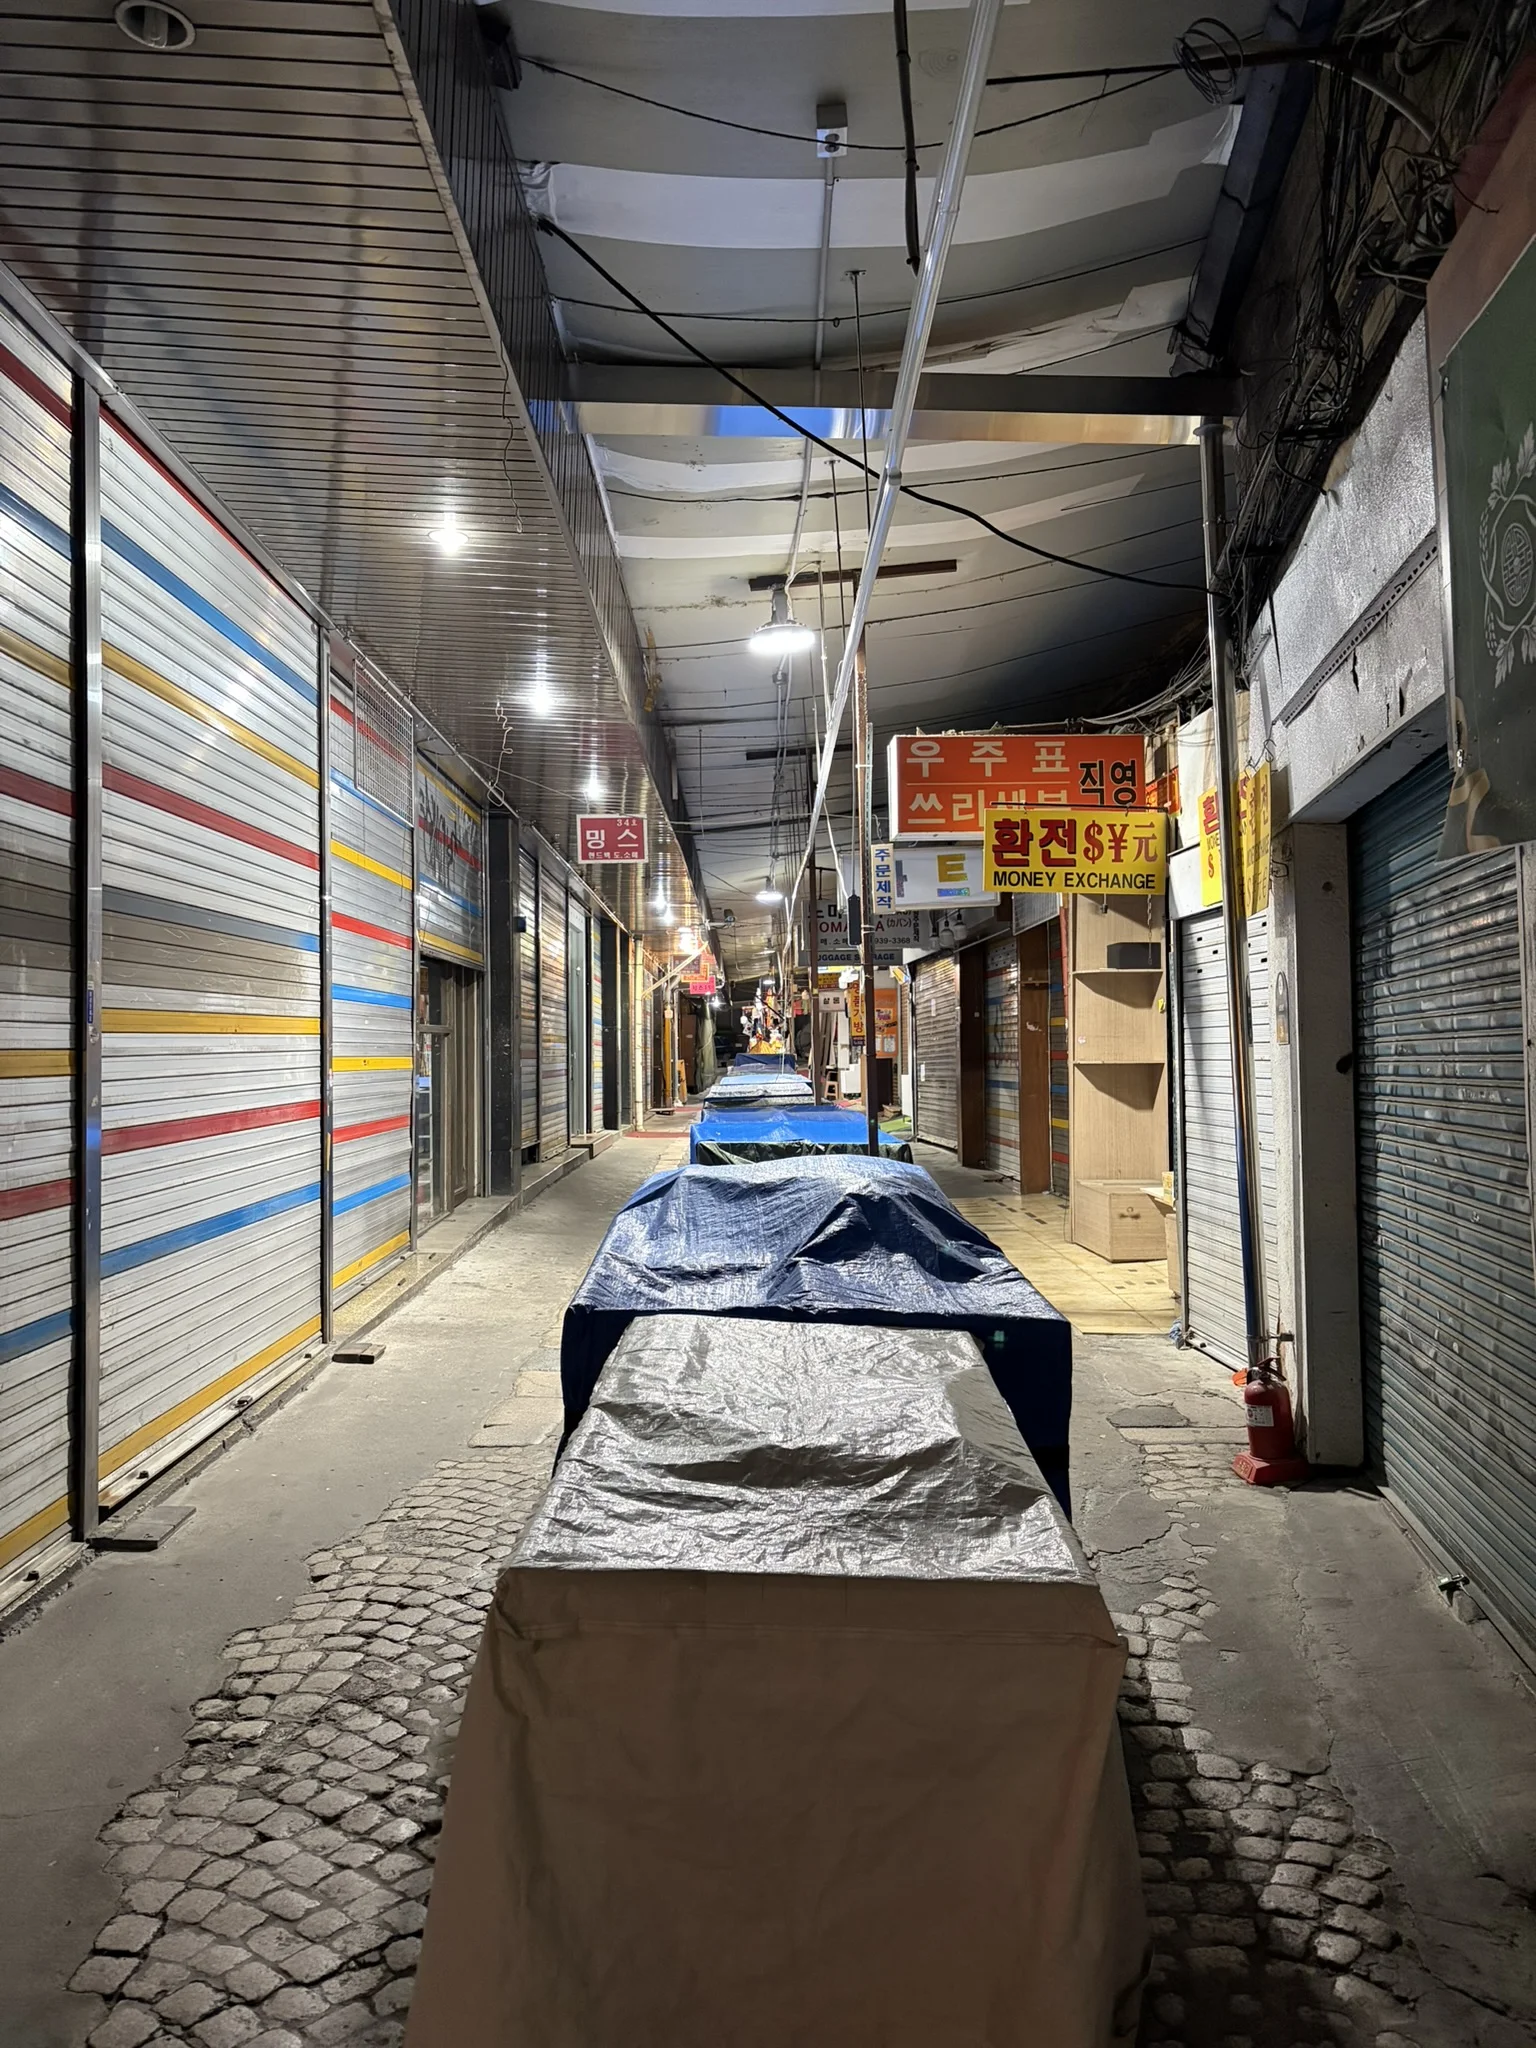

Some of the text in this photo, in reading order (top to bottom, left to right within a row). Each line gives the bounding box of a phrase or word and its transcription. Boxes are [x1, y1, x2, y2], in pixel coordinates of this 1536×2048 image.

[1079, 759, 1138, 806] 직영
[585, 829, 639, 849] 밍스
[875, 848, 892, 909] 주문제작
[993, 871, 1156, 889] MONEY EXCHANGE
